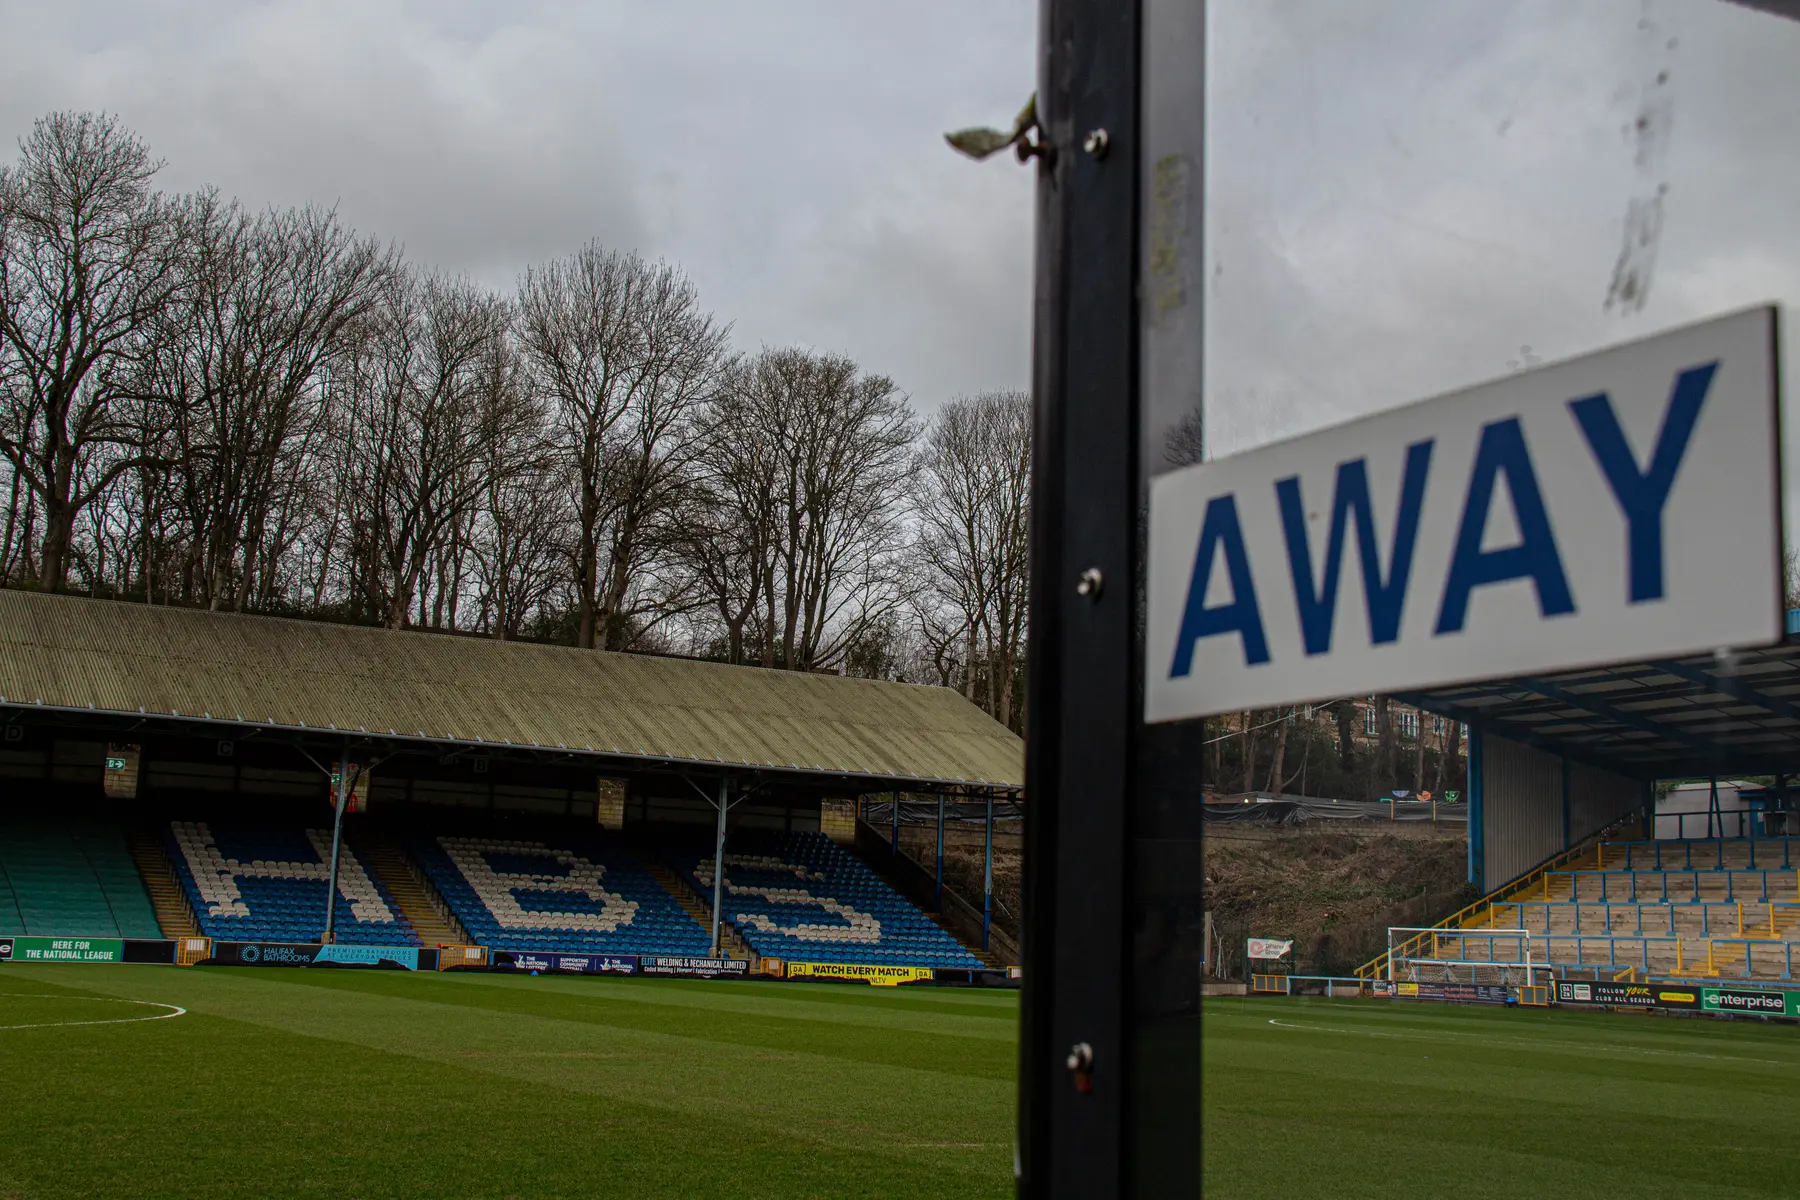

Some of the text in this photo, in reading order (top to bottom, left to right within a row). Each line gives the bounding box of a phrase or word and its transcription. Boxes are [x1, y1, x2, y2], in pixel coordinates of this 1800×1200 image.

[1168, 359, 1722, 681] AWAY
[52, 940, 90, 950] HERE FOR
[26, 950, 114, 960] THE NATIONAL LEAGUE
[263, 954, 310, 962] BATHROOMS
[641, 958, 747, 970] ELITE WELDING & MECHANICAL LIMITED
[812, 965, 910, 976] WATCH EVERY MATCH
[1708, 994, 1784, 1008] enterprise
